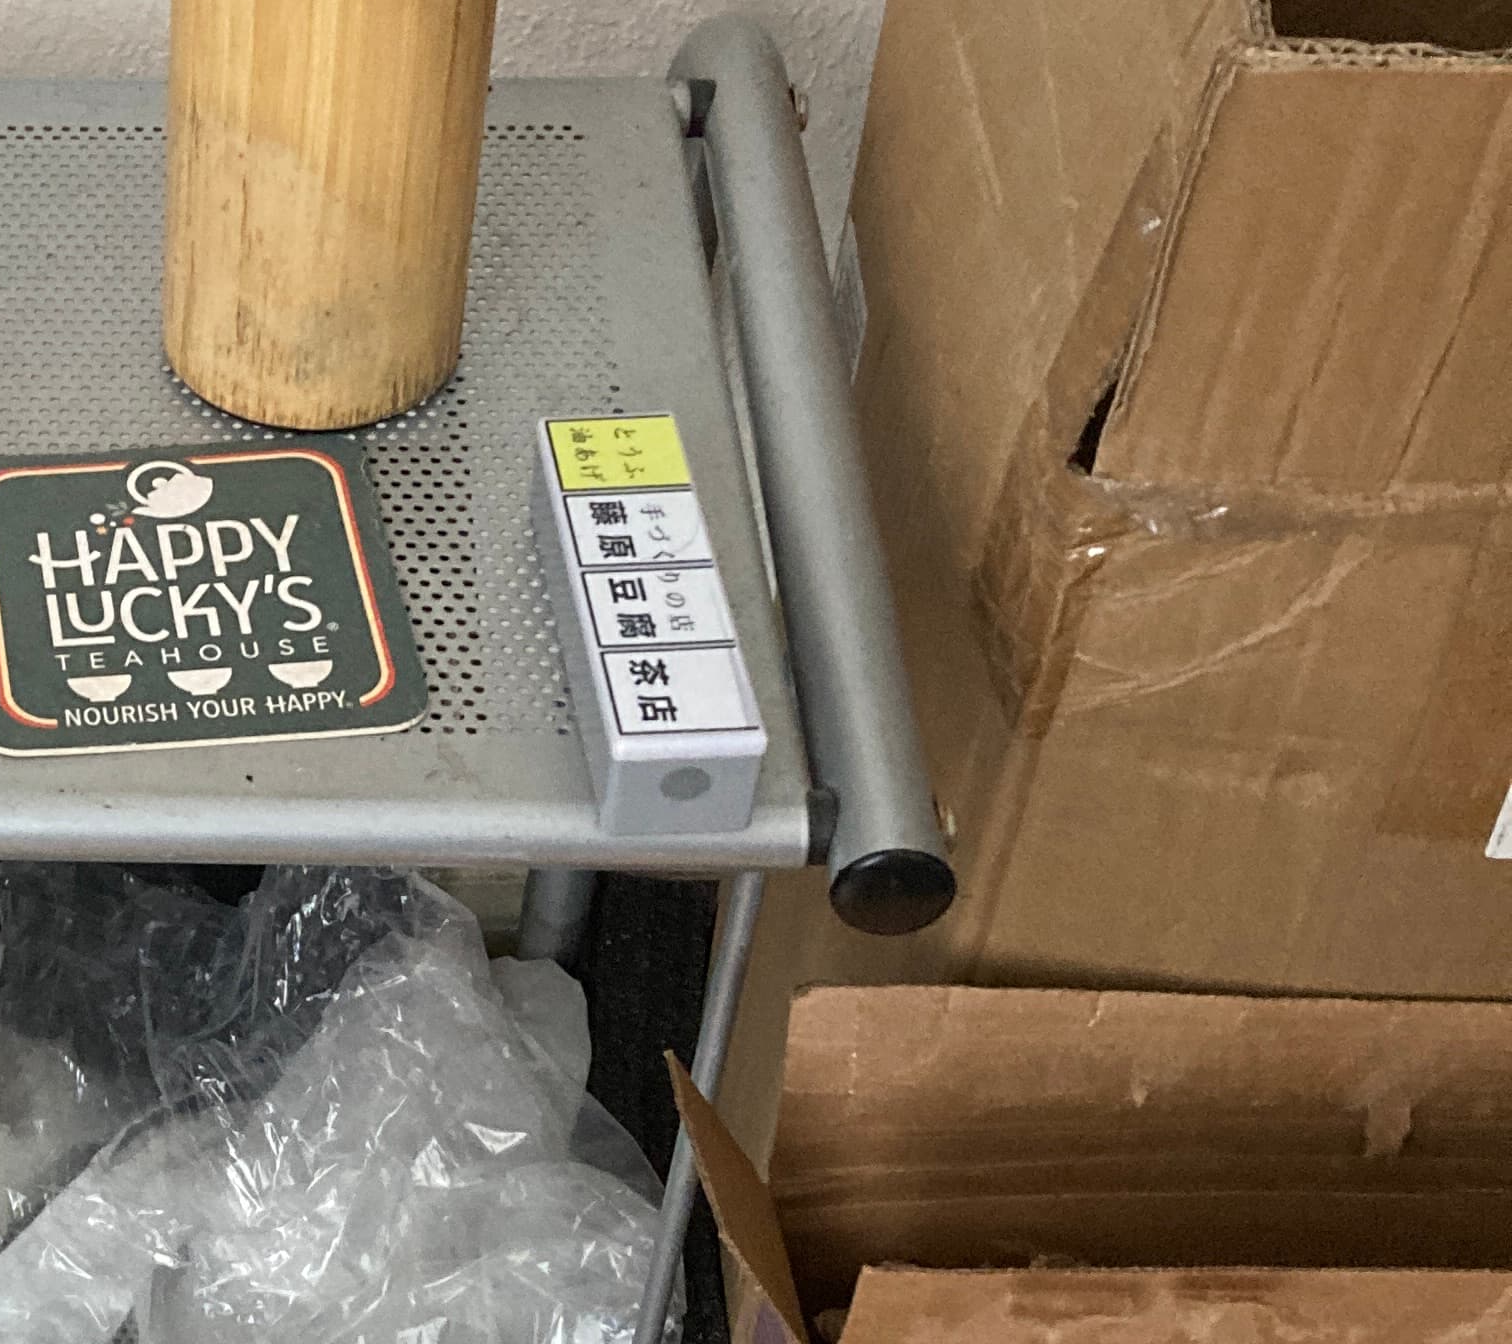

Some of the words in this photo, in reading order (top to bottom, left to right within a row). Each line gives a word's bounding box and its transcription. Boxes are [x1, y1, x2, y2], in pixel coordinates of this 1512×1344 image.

[568, 427, 607, 482] 油あげ
[613, 427, 645, 479] とうふ
[29, 514, 299, 589] HAPPY
[46, 574, 322, 647] LUCKY'S
[55, 636, 330, 671] TEAHOUSE
[64, 703, 178, 727] NOURISH
[187, 697, 256, 719] YOUR
